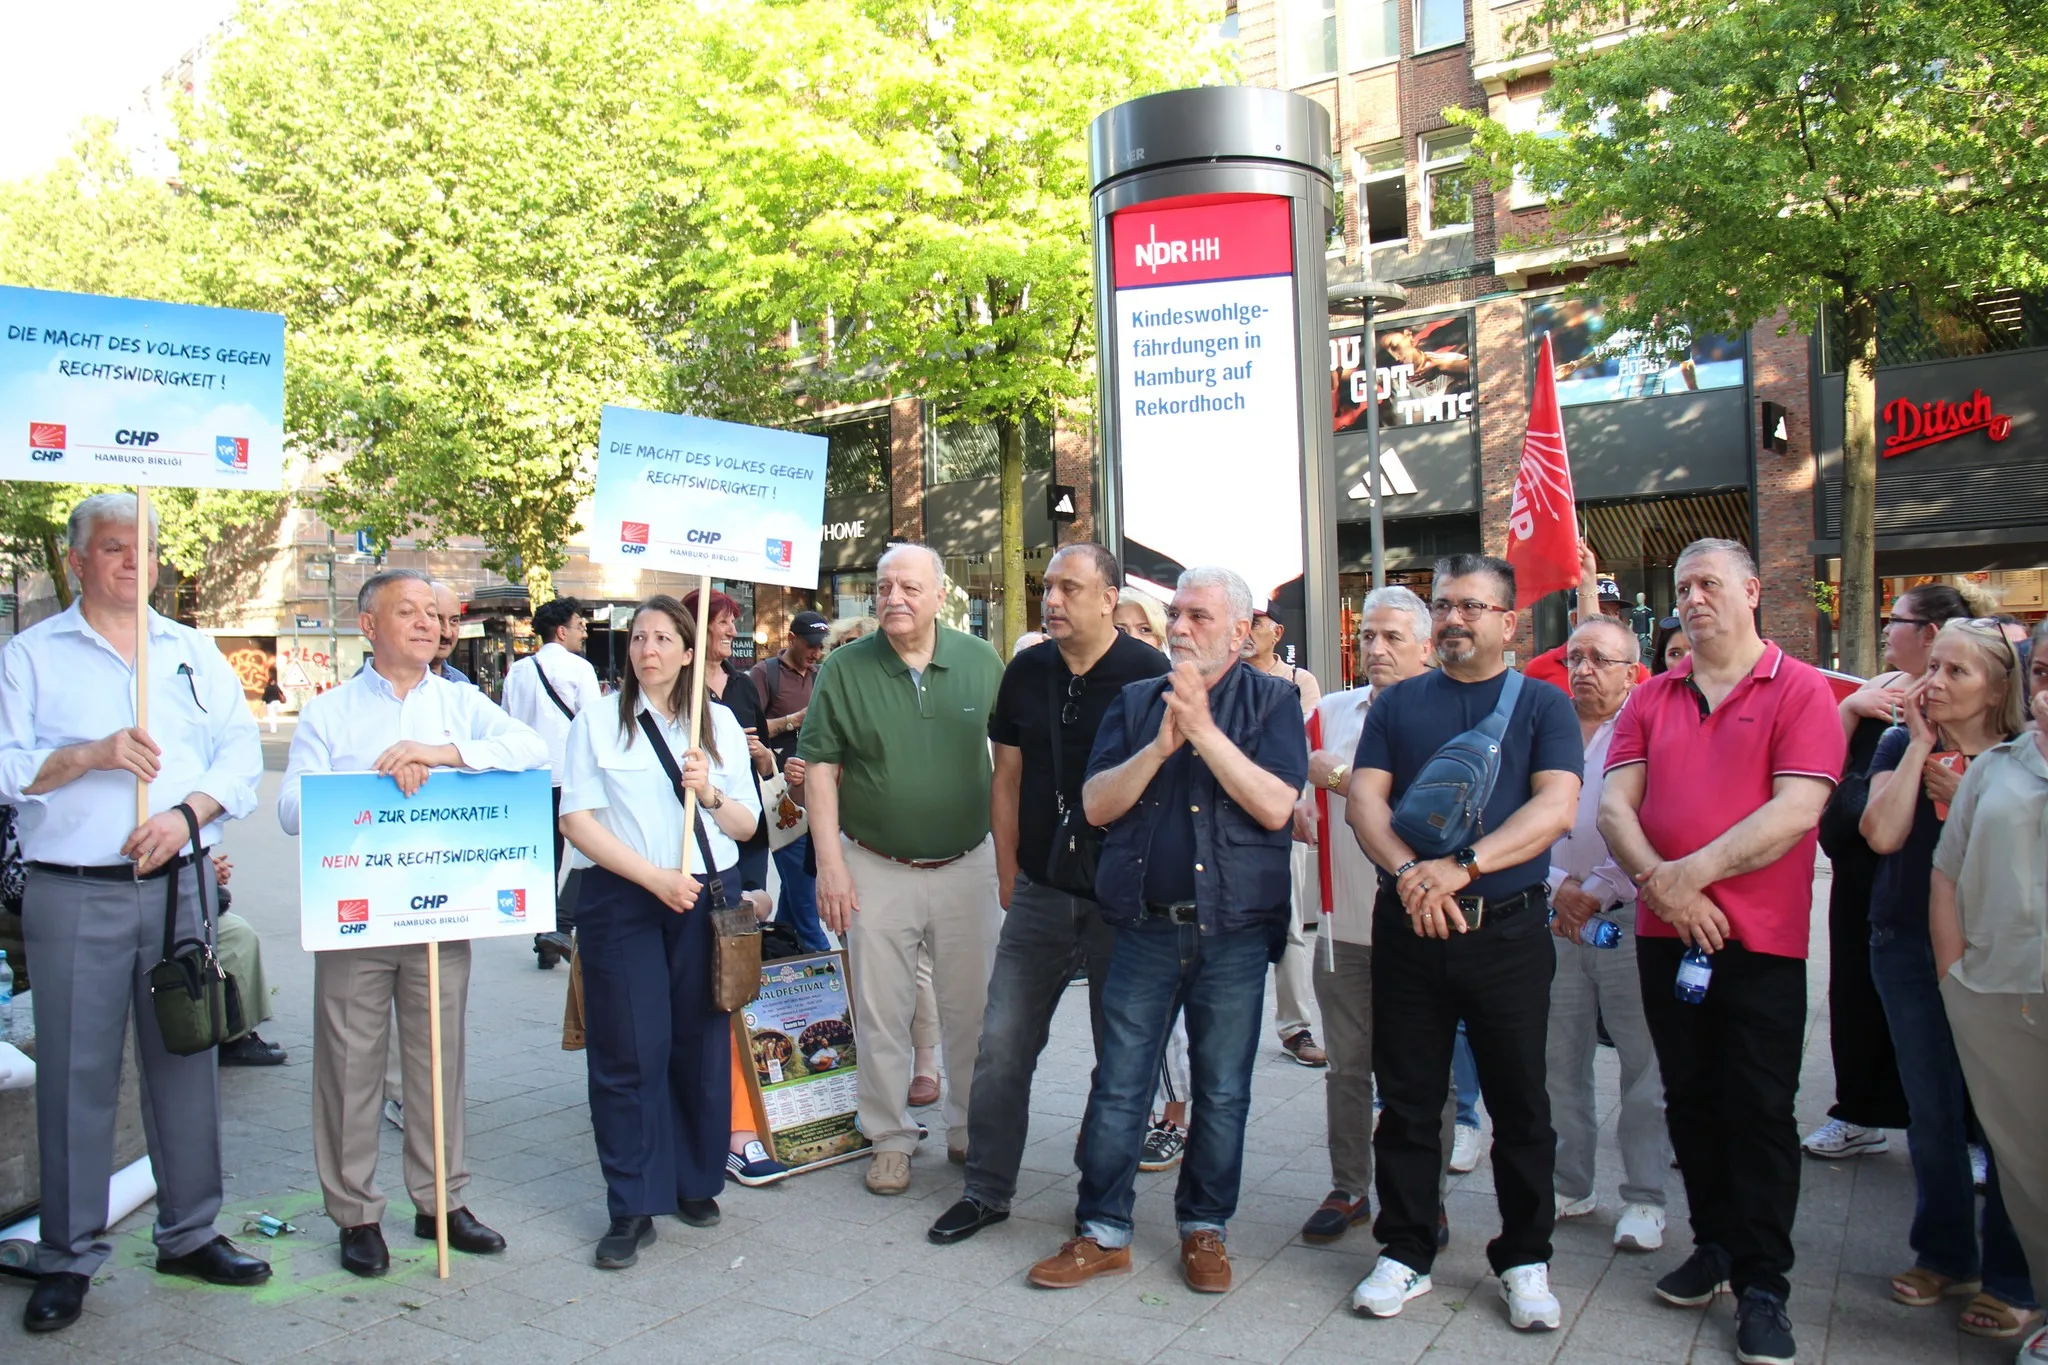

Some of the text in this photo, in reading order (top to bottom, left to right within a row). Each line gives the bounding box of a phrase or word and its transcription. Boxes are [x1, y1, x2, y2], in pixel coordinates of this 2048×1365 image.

[1135, 224, 1220, 274] NDR HH
[1132, 303, 1269, 328] Kindeswohlge-
[8, 325, 271, 367] DIE MACHT DES VOLKES GEGEN
[1133, 332, 1261, 358] fährdungen in
[59, 360, 216, 389] RECHTSWIDRIGKEIT
[1134, 361, 1253, 388] Hamburg auf
[1350, 363, 1415, 404] GOT
[1135, 392, 1245, 417] Rekordhoch
[1397, 392, 1472, 426] THIS
[1883, 388, 1992, 446] Ditsch
[115, 430, 159, 446] CHP
[32, 450, 64, 461] CHP
[94, 453, 145, 464] HAMBURG
[610, 441, 814, 480] DIE MACHT DES VOLKES GEGEN
[647, 470, 768, 499] RECHTSWIDRIGKEIT
[687, 529, 721, 545] CHP
[621, 544, 646, 555] CHP
[670, 548, 709, 559] HAMBURG
[732, 649, 753, 658] NEUE
[353, 810, 372, 825] JA
[378, 809, 405, 824] ZUR
[410, 805, 499, 822] DEMOKRATIE
[322, 855, 359, 869] NEIN
[365, 853, 394, 867] ZUR
[398, 846, 529, 867] RECHTSWIDRIGKEIT
[410, 894, 448, 910] CHP
[340, 924, 367, 935] CHP
[393, 917, 437, 927] HAMBURG
